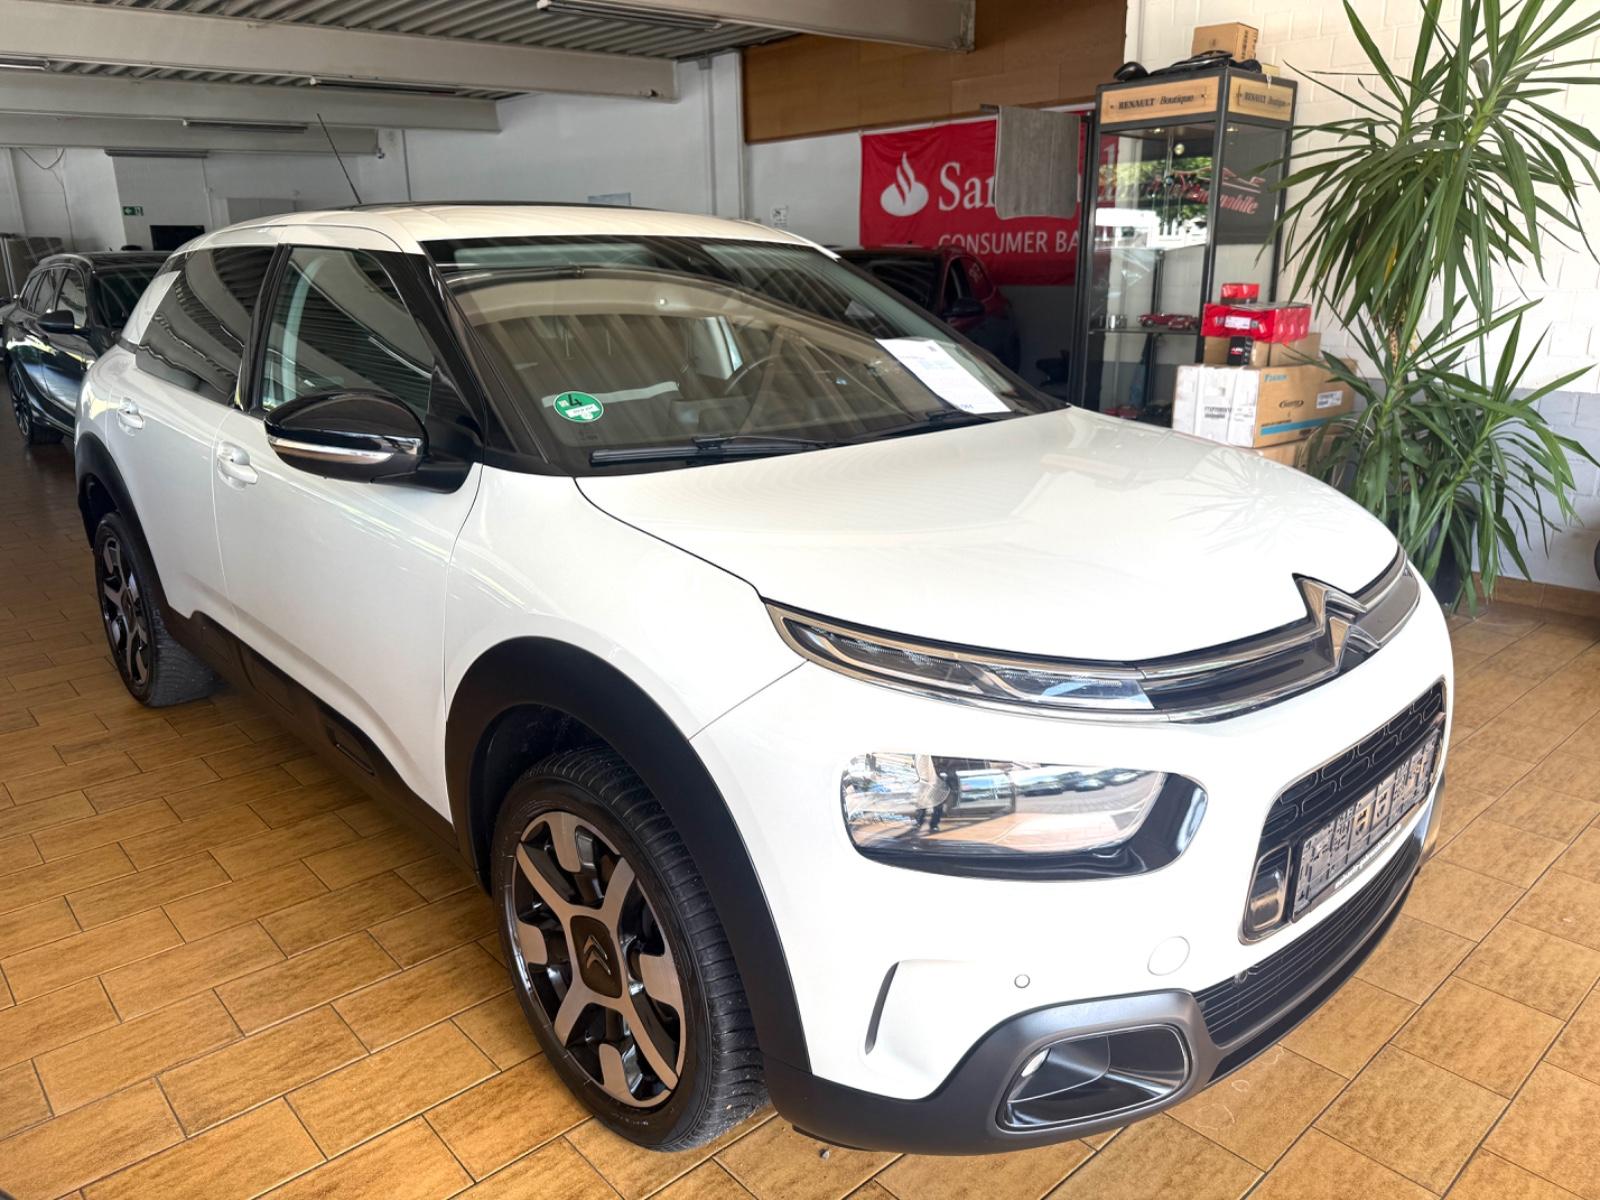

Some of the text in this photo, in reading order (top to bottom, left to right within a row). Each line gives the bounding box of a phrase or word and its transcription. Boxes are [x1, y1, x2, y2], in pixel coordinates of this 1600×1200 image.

[1118, 94, 1195, 110] RENAULT Boutique
[938, 231, 1048, 255] CONSUMER
[567, 394, 582, 406] 4
